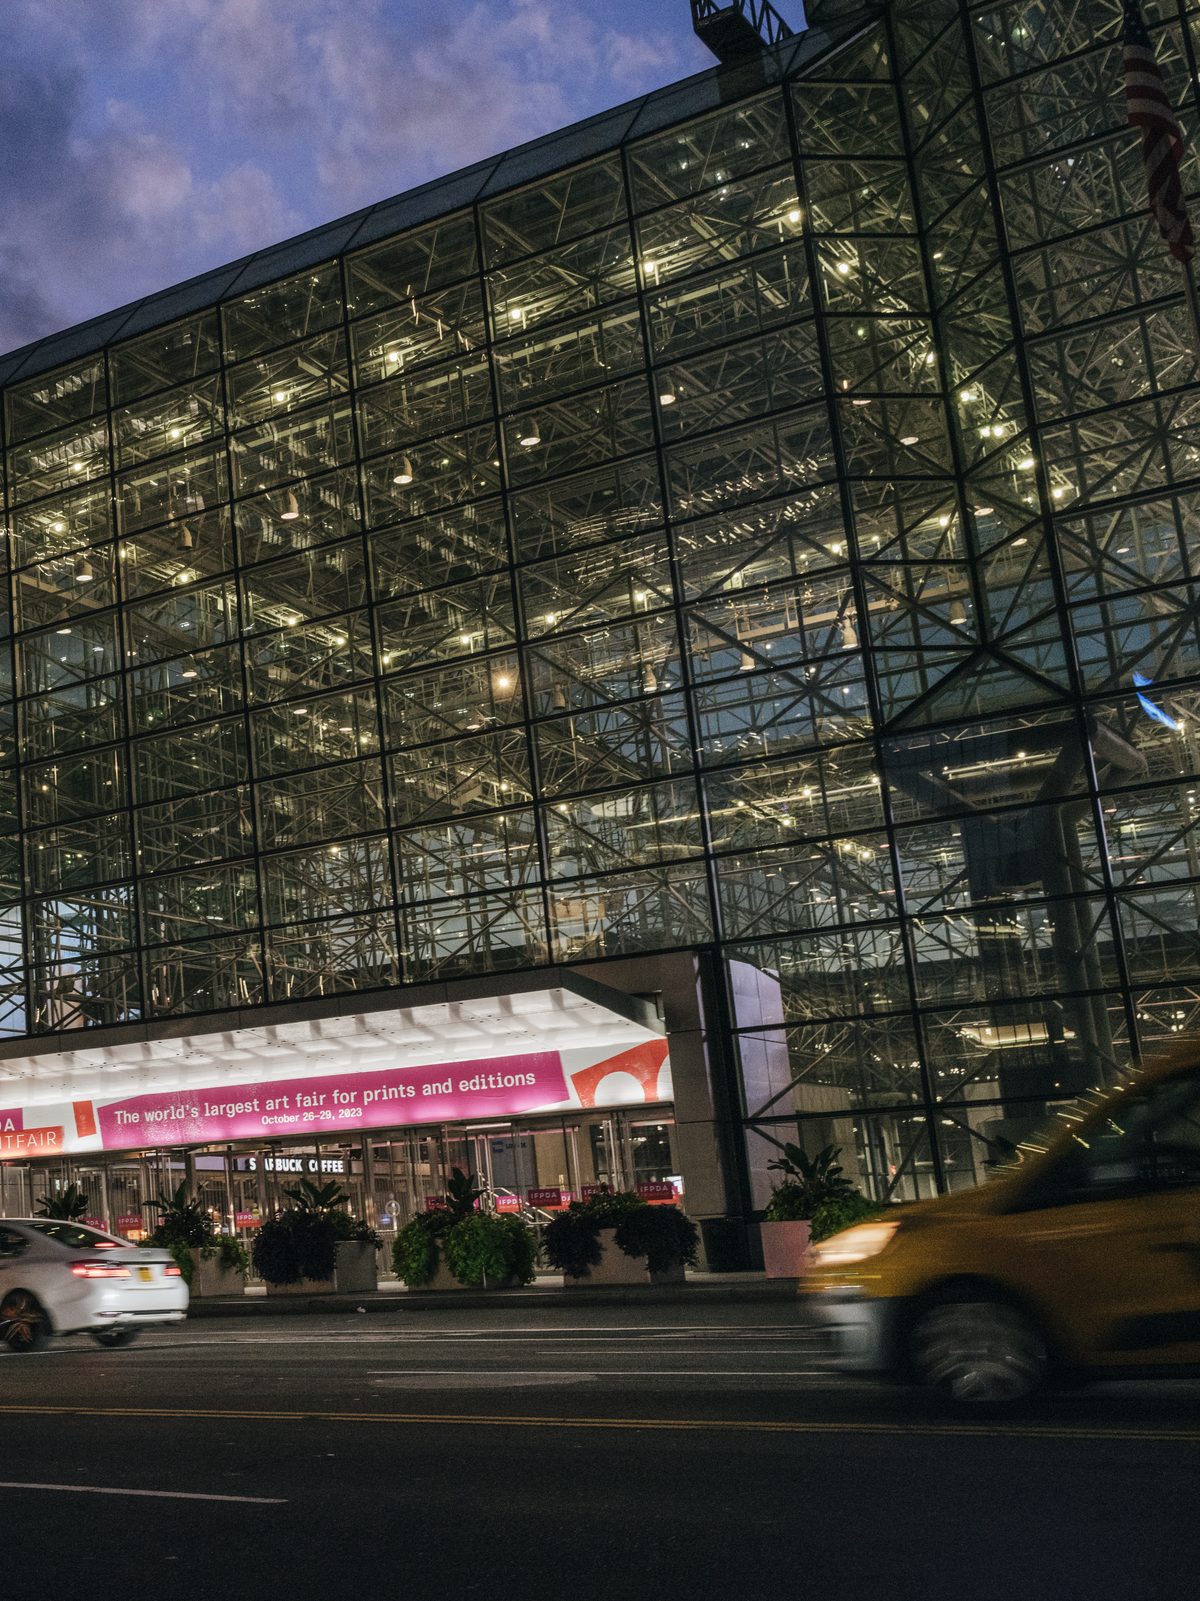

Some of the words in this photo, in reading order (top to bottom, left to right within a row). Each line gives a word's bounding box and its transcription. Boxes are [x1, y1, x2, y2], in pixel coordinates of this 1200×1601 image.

[114, 1110, 140, 1124] The
[144, 1104, 199, 1122] world's
[204, 1098, 260, 1118] largest
[265, 1095, 290, 1111] art
[295, 1091, 327, 1108] fair
[332, 1089, 358, 1104] for
[363, 1084, 416, 1106] prints
[422, 1077, 453, 1096] and
[459, 1072, 536, 1092] editions
[261, 1113, 300, 1125] October
[338, 1107, 363, 1119] 2023
[530, 1191, 558, 1199] IFPDA
[639, 1185, 669, 1193] IFPDA
